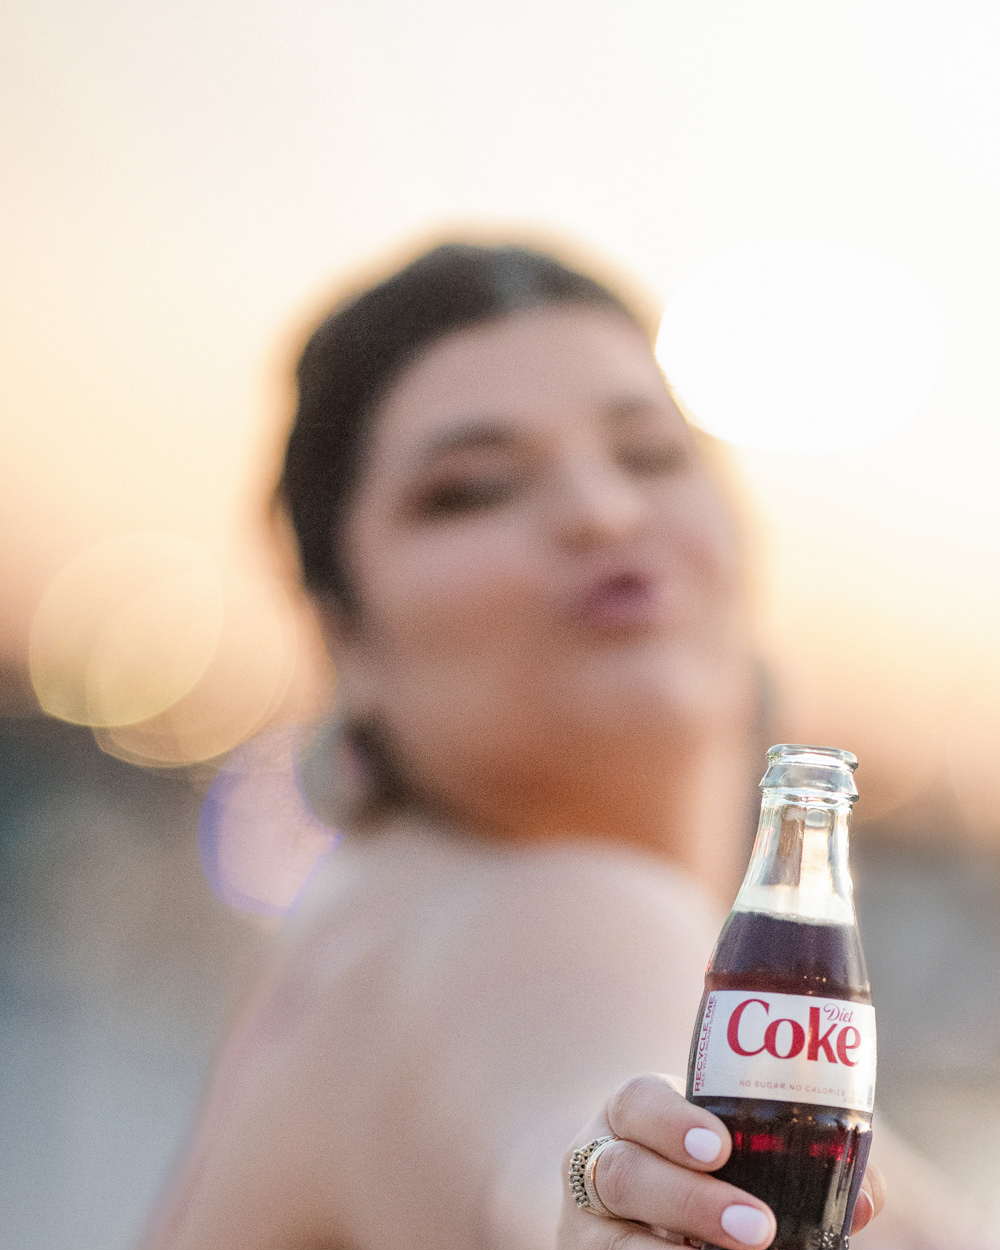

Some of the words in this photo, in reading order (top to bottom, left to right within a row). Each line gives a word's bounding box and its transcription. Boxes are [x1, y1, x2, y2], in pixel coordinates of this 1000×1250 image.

[727, 998, 861, 1067] Coke
[823, 1003, 853, 1023] Diet
[695, 1022, 709, 1092] RECYCLE
[705, 995, 715, 1018] ME
[754, 1080, 786, 1090] SUGAR
[789, 1083, 802, 1092] NO
[804, 1085, 846, 1097] CALORIES
